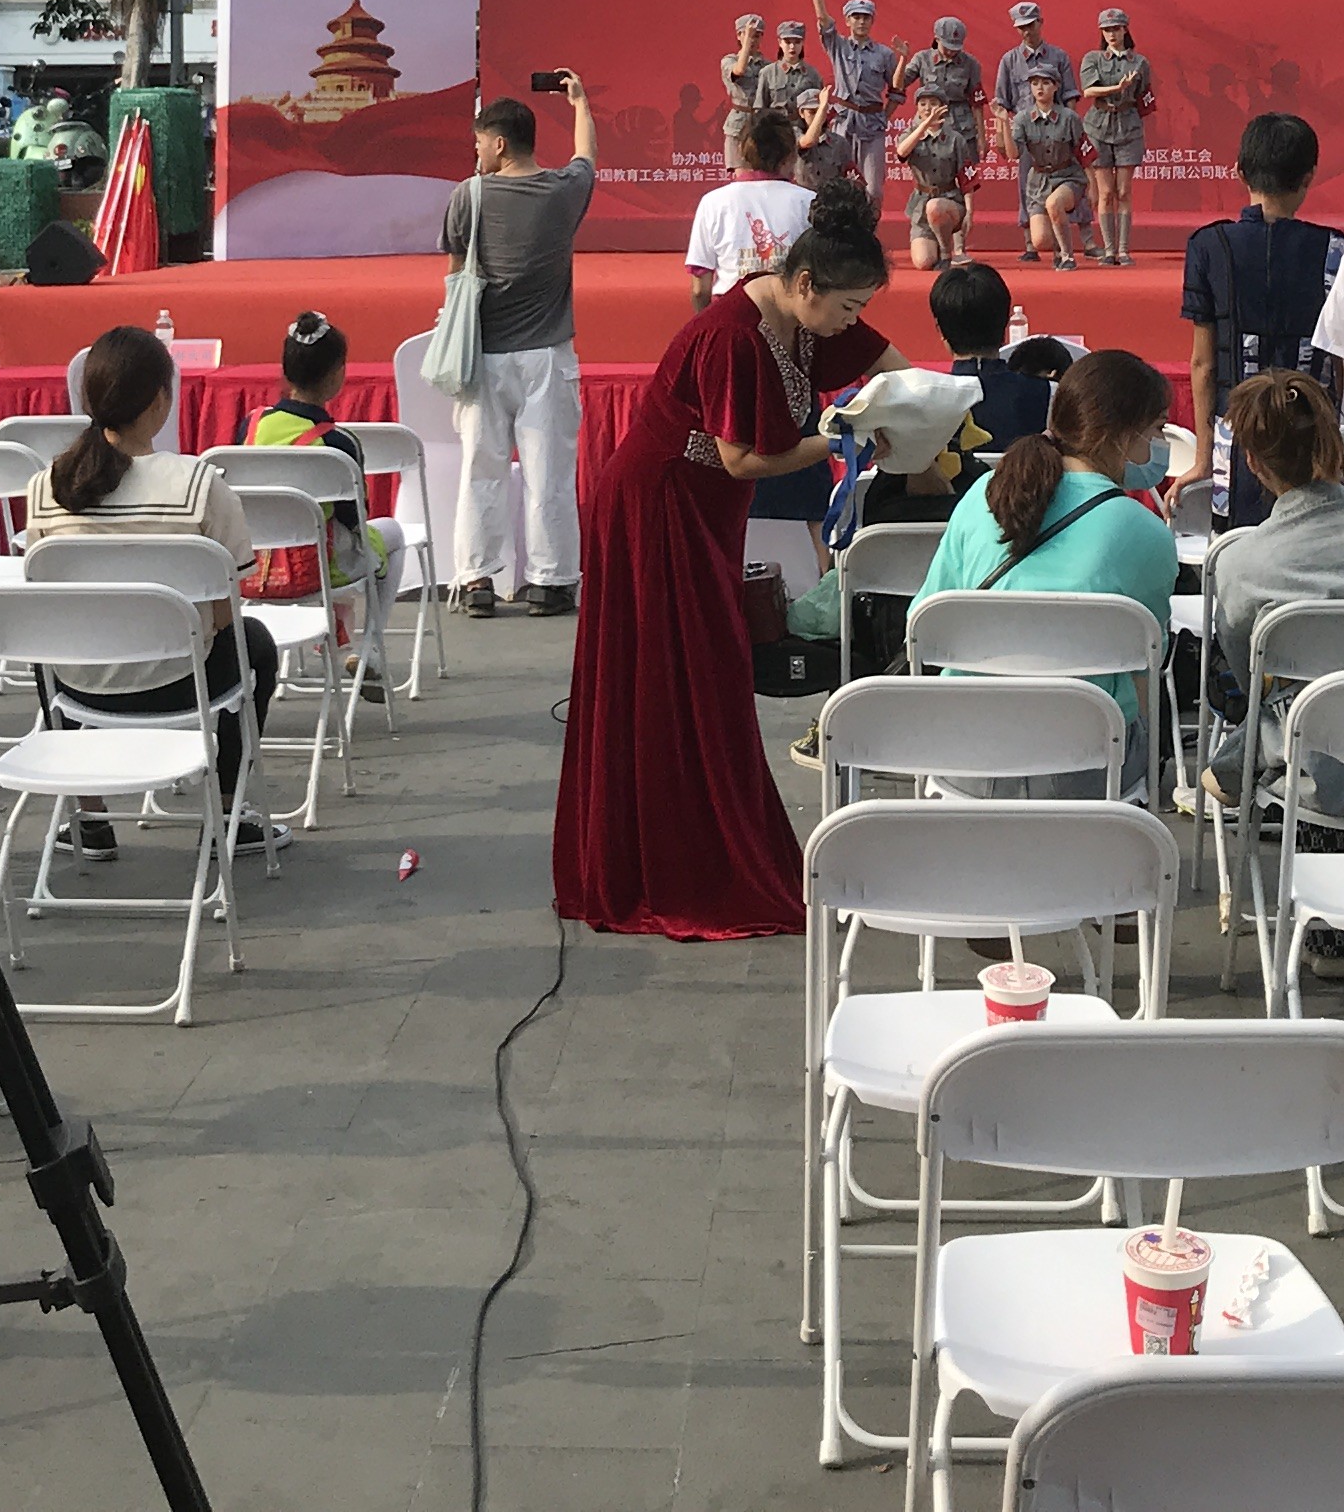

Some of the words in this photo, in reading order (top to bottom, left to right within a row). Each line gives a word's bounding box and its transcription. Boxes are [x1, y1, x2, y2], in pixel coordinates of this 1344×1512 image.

[671, 152, 725, 166] 协办单位
[594, 168, 737, 182] 国教育工会海南省三亚
